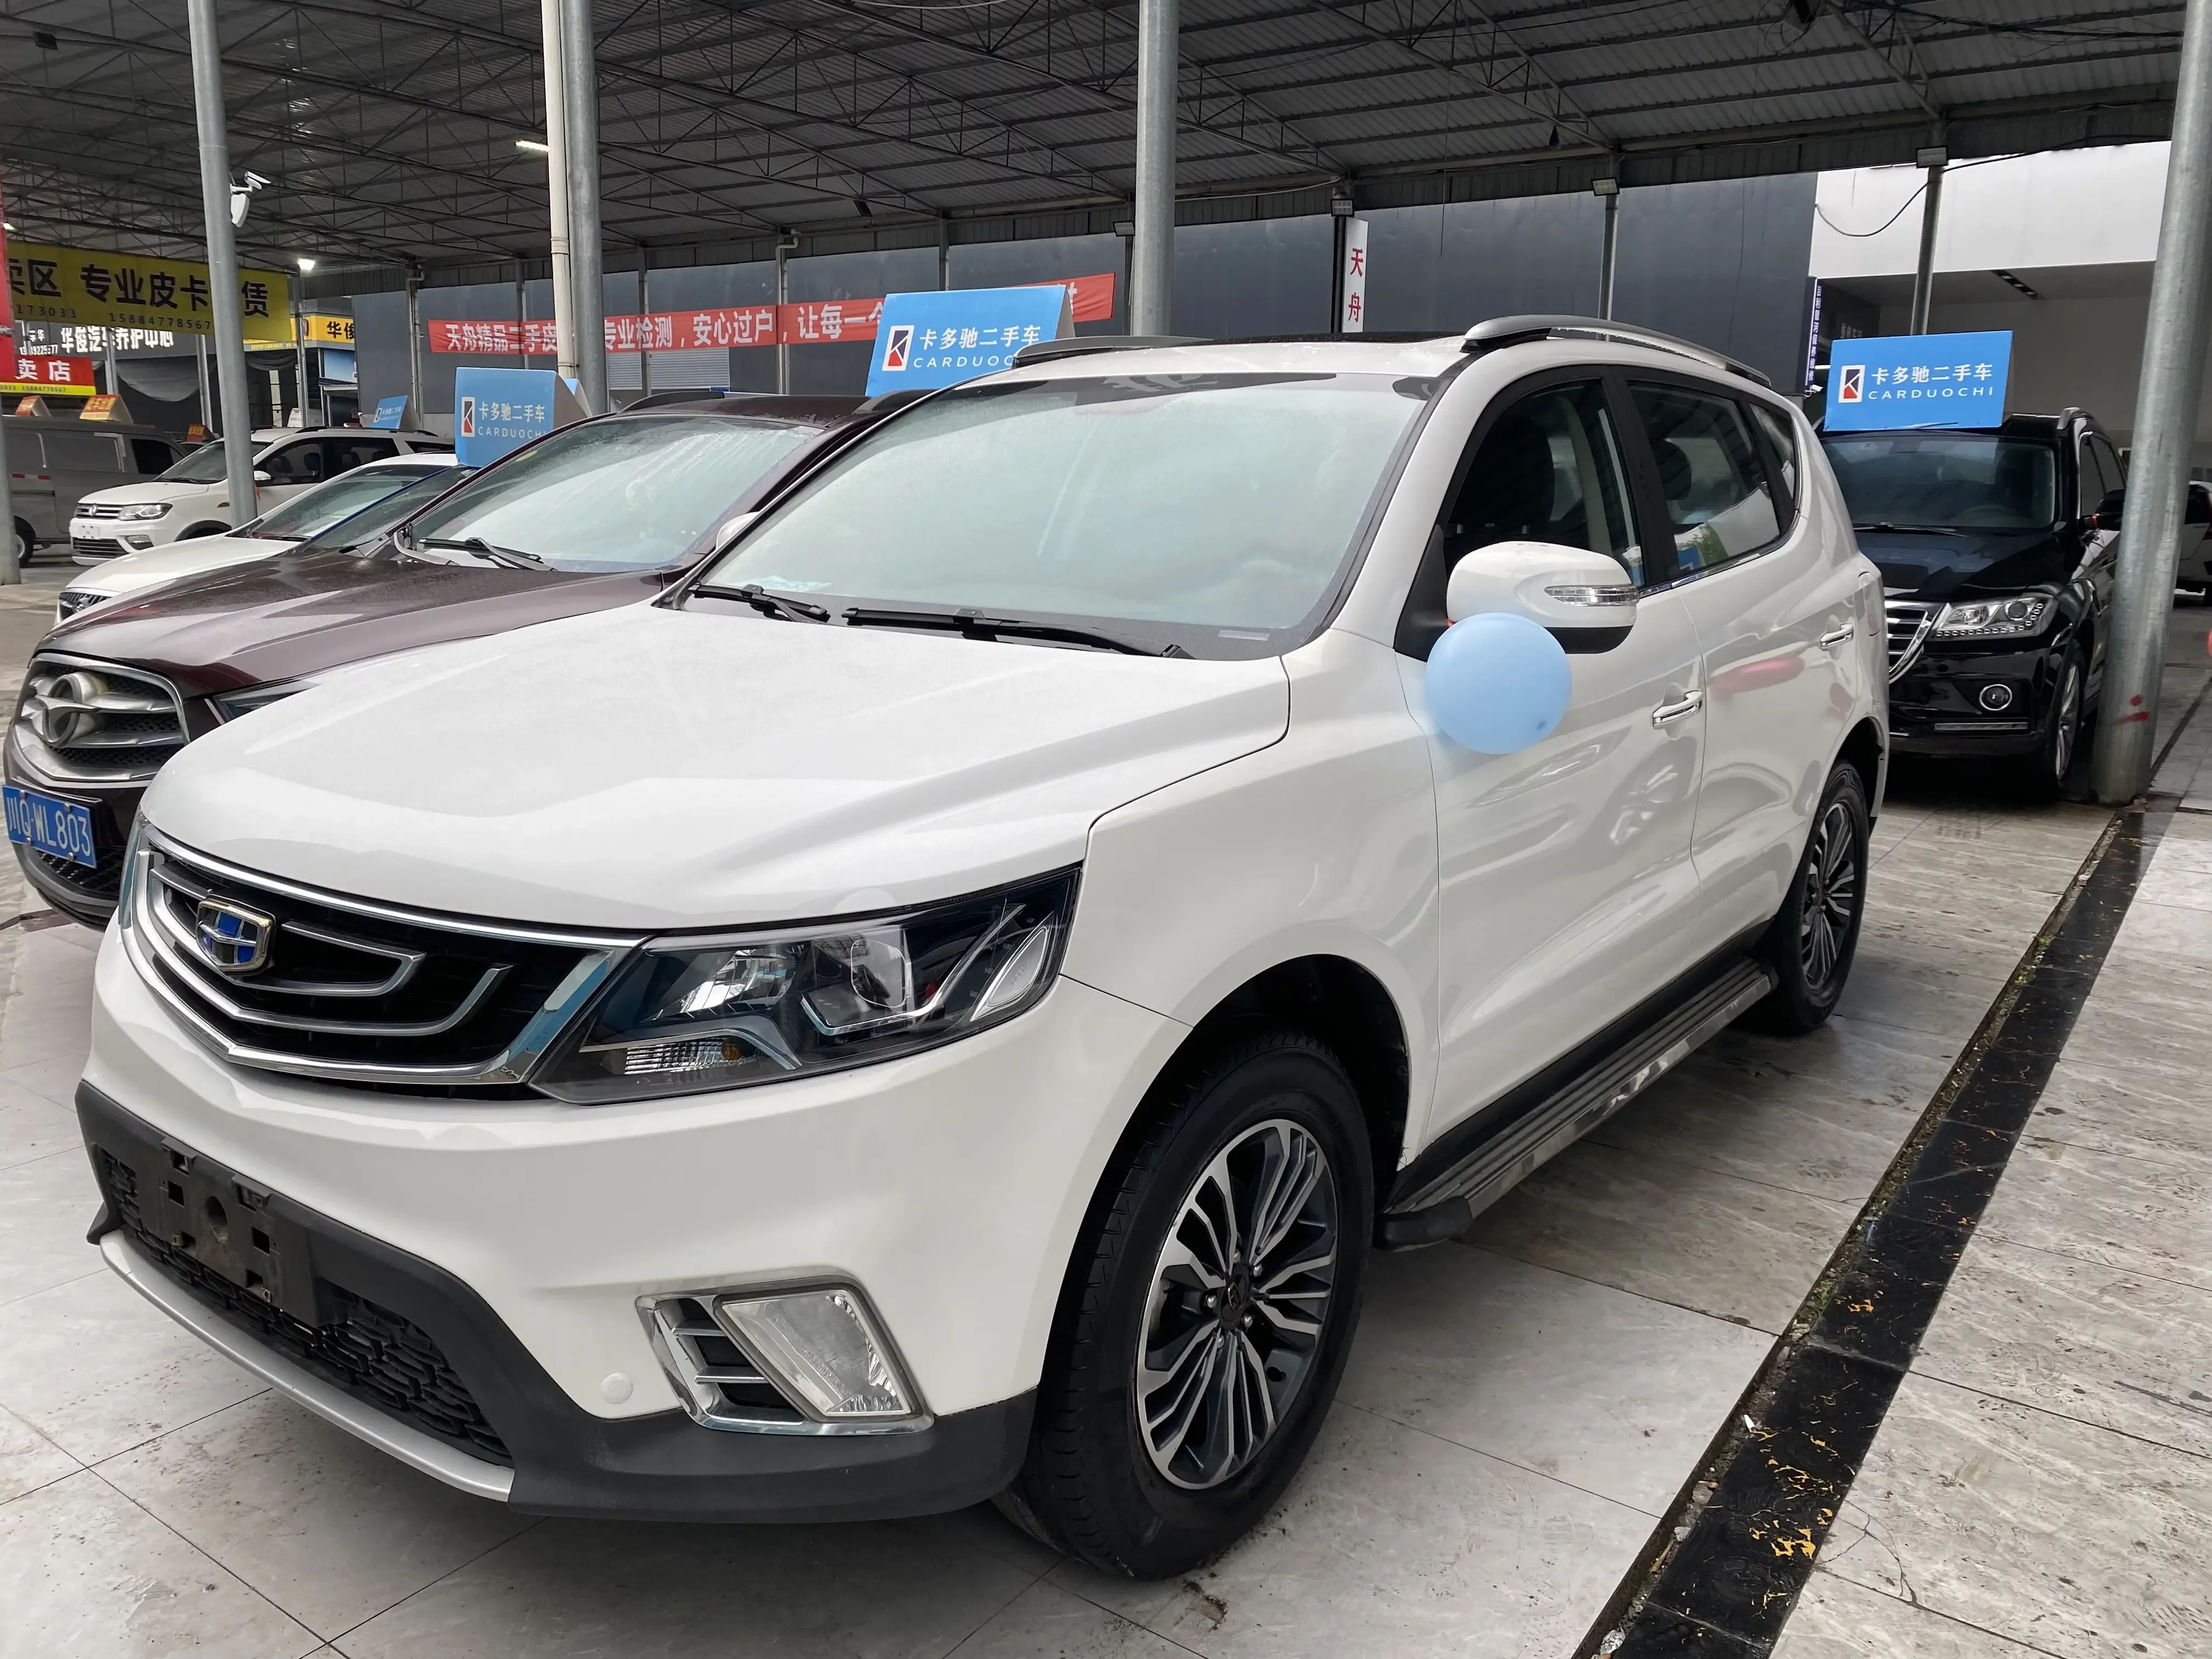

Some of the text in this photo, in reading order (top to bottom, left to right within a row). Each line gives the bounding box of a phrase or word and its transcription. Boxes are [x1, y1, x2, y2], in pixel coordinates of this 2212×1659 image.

[80, 263, 269, 318] 专业皮卡赁
[1348, 248, 1363, 322] 天舟
[109, 313, 211, 329] 15884778567
[919, 325, 1041, 350] 卡多驰二手车
[14, 358, 71, 382] 卖店
[1871, 363, 1993, 385] 卡多驰二手车
[1868, 387, 1993, 399] CARDUOCHI
[478, 401, 545, 423] 卡多驰二手车
[478, 426, 547, 439] CARDUOCH
